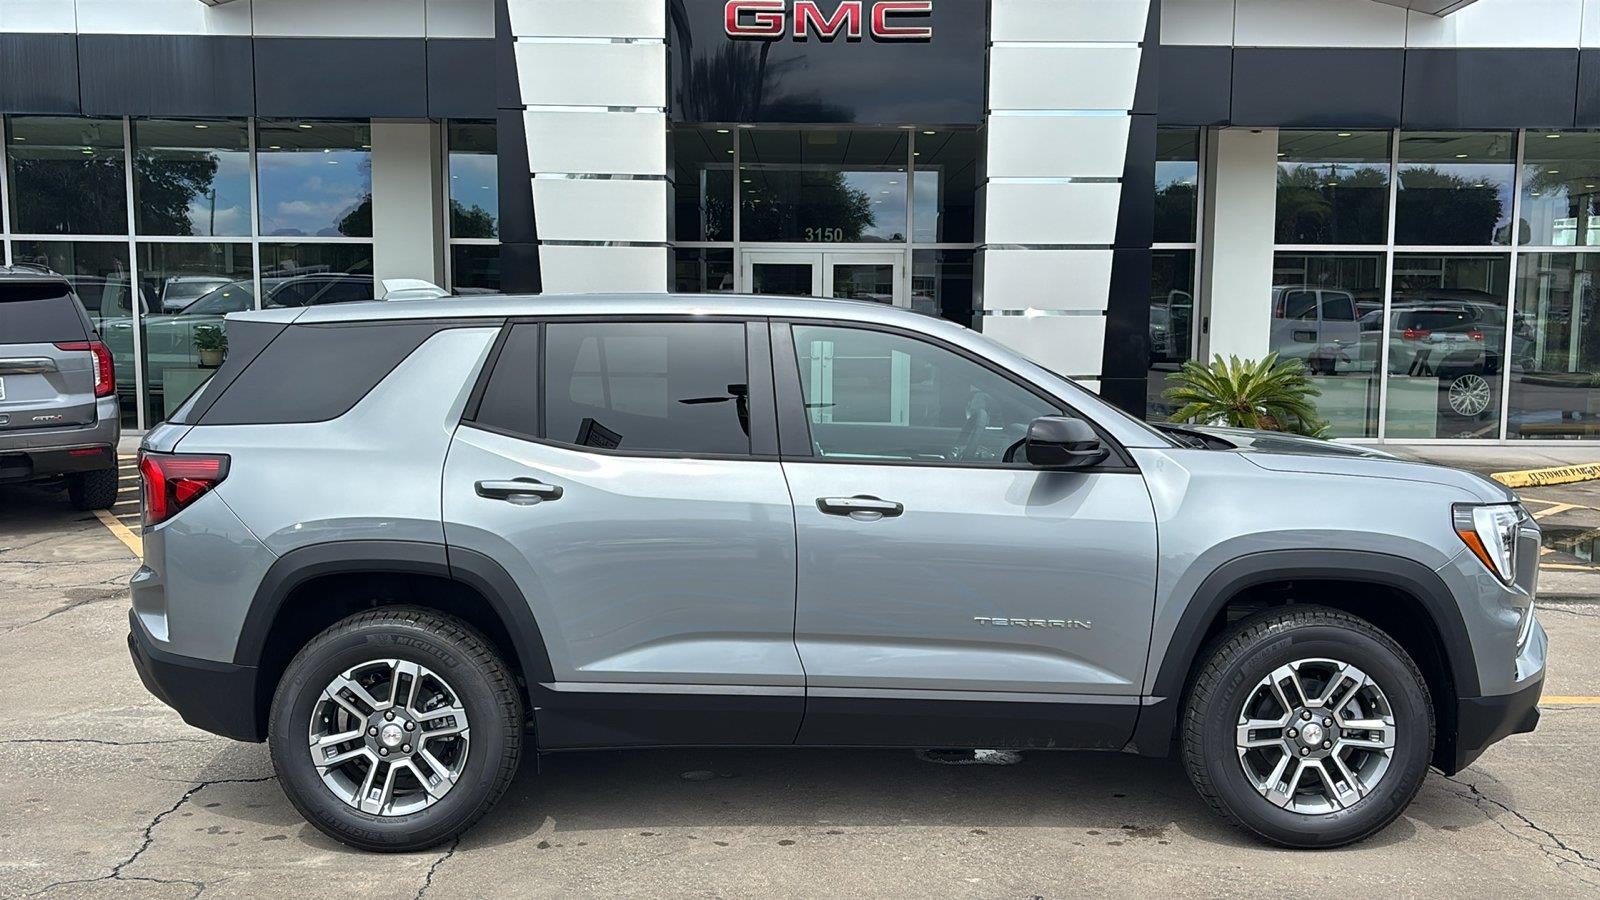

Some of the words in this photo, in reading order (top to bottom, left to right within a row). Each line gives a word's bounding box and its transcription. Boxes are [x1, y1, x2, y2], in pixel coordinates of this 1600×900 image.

[724, 0, 933, 38] GMC
[805, 227, 843, 241] 3150
[1528, 469, 1571, 481] CUSTOMER
[974, 616, 1092, 630] TERRAIN
